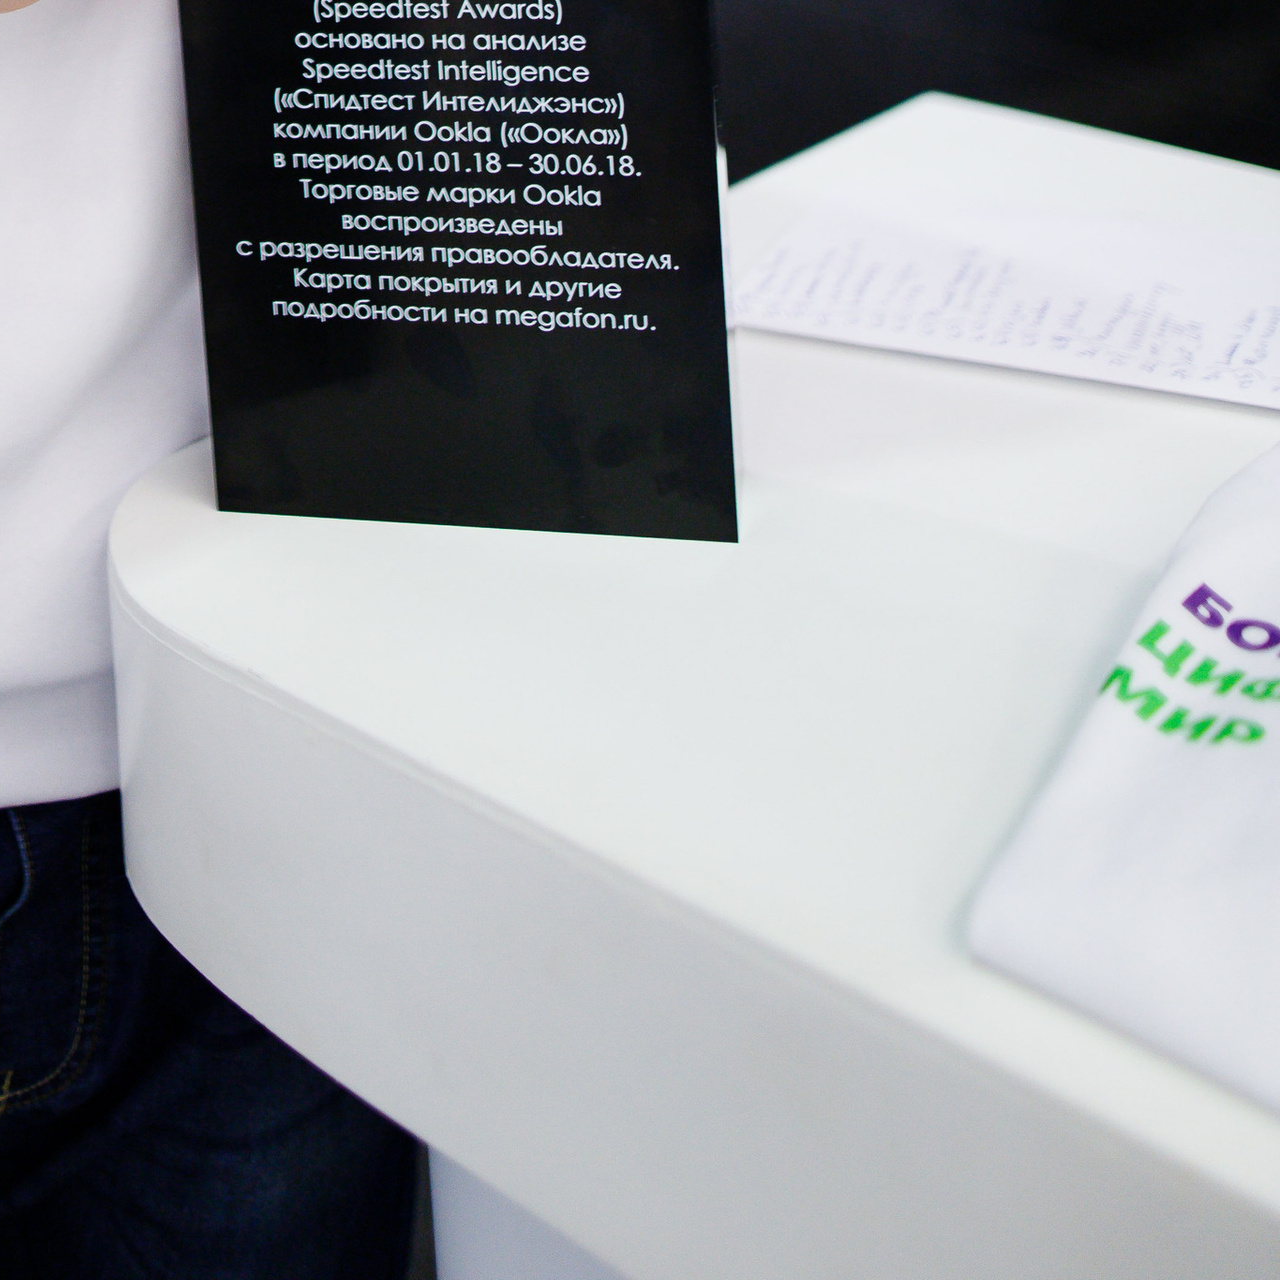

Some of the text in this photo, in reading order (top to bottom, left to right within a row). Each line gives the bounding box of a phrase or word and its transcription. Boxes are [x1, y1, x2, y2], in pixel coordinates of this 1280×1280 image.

[294, 32, 587, 52] основано на анализе
[302, 57, 590, 87] Speedtest Intelligence
[274, 87, 625, 120] («Спидтест Интелиджэнс»)
[273, 120, 628, 151] компании Ookla («Оокла»)
[273, 152, 287, 168] в
[292, 153, 393, 174] период
[397, 150, 502, 174] 01.01.18
[528, 153, 642, 177] 30.06.18.
[298, 178, 602, 208] Торговые марки Ookla
[341, 214, 564, 237] воспроизведены
[235, 240, 680, 271] с разрешения правообладателя.
[293, 267, 622, 302] Карта покрытия и другие
[272, 299, 657, 332] подробности на megafon.ru.
[1181, 582, 1280, 658] БО
[1099, 665, 1266, 744] МИР
